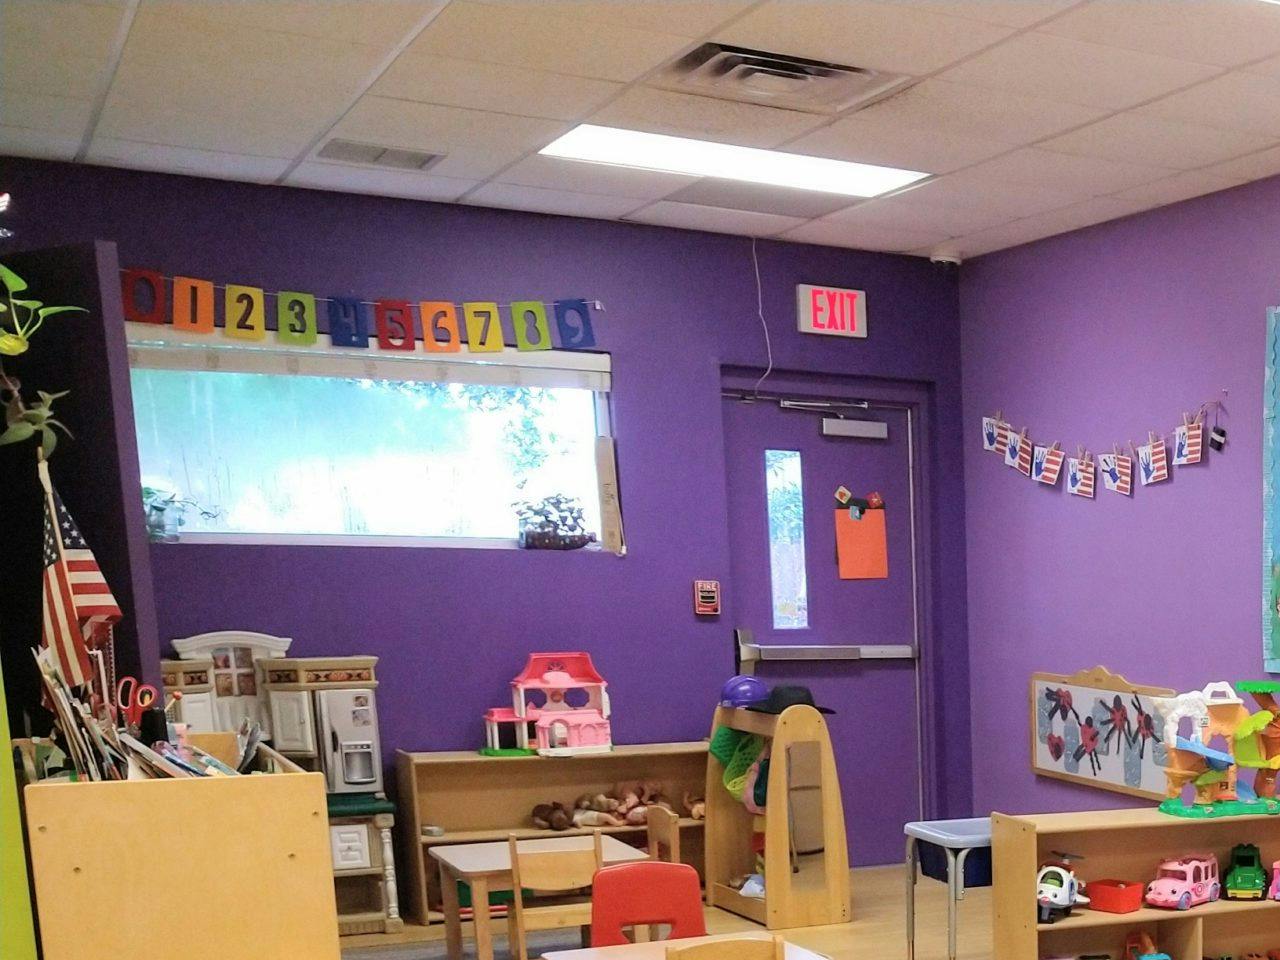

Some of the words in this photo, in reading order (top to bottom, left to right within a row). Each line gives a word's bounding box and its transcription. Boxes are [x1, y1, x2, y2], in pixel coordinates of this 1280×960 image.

[189, 286, 199, 324] 1
[236, 293, 255, 331] 2
[288, 299, 307, 334] 3
[386, 308, 407, 347] 5
[432, 310, 450, 347] 6
[473, 310, 492, 346] 7
[523, 310, 541, 345] 8
[564, 308, 585, 344] 9
[811, 288, 858, 333] EXIT
[698, 582, 717, 590] FIRE
